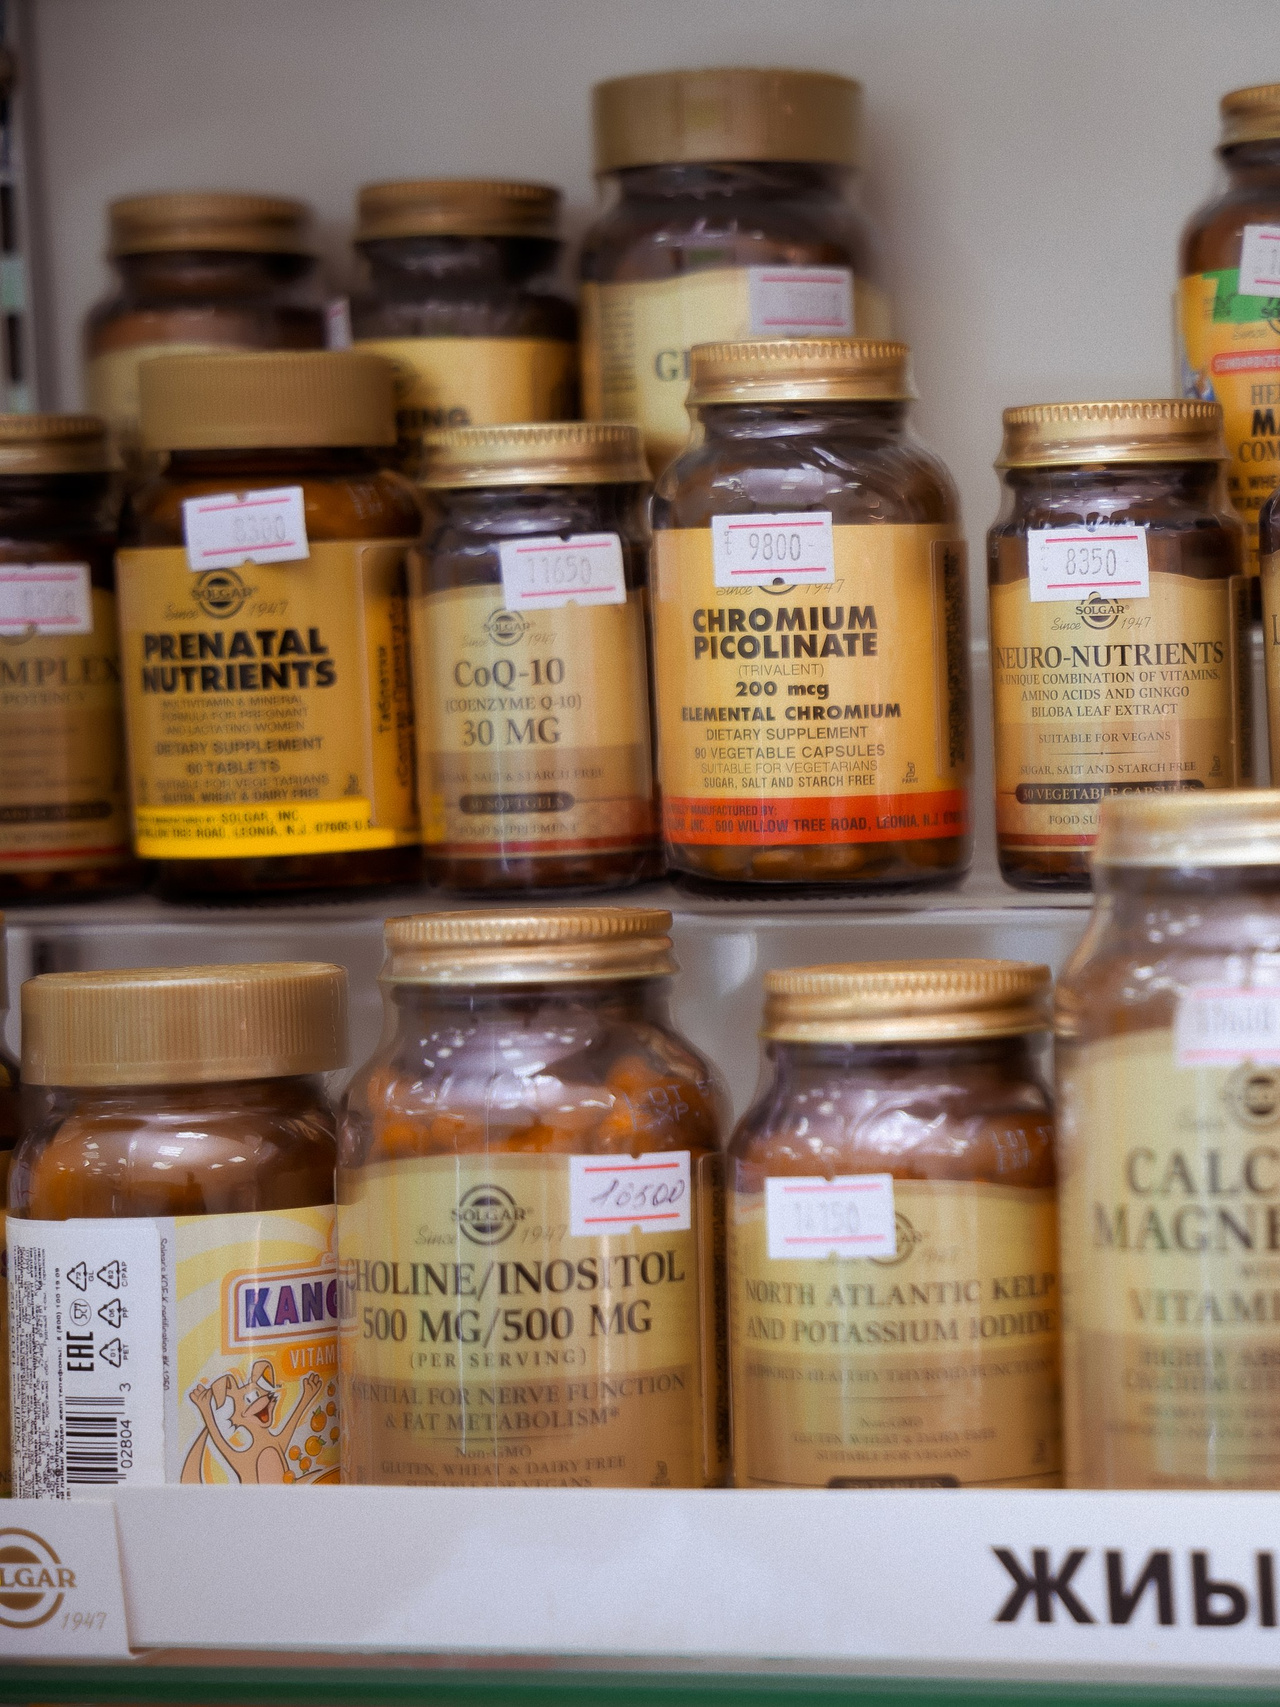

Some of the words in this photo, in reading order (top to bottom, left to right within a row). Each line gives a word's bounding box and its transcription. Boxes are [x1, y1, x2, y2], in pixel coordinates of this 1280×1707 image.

[749, 533, 801, 561] 9800
[1066, 548, 1117, 577] 8350
[1076, 605, 1125, 615] SOLGAR
[693, 606, 877, 633] CHROMIUM
[1051, 618, 1081, 631] Since
[1121, 617, 1151, 629] 1947
[143, 628, 329, 660] PRENATAL
[694, 632, 878, 660] PICOLINATE
[997, 641, 1223, 670] NEURO-NUTRIENTS
[143, 660, 337, 694] NUTRIENTS
[454, 656, 565, 689] CoQ-10
[738, 664, 824, 677] (TRIVALENT)
[1042, 672, 1135, 684] COMBINATION
[1139, 671, 1156, 682] OF
[735, 681, 777, 696] 200
[788, 682, 829, 699] mcg
[1022, 690, 1058, 701] AMINO
[1062, 689, 1100, 700] ACIDS
[1105, 688, 1135, 699] AND
[1139, 686, 1190, 698] GINKGO
[445, 695, 537, 713] (COENZYME
[541, 694, 582, 710] Q-10)
[682, 706, 775, 721] ELEMENTAL
[786, 703, 900, 720] CHROMIUM
[1031, 706, 1073, 718] BILOBA
[1076, 706, 1111, 717] LEAF
[1116, 703, 1178, 716] EXTRACT
[463, 719, 494, 746] 30
[506, 717, 561, 744] MG
[706, 728, 760, 741] DIETARY
[766, 726, 869, 740] SUPPLEMENT
[1038, 733, 1092, 744] SUITABLE
[1095, 733, 1119, 743] FOR
[1123, 731, 1171, 742] VEGANS
[213, 737, 323, 753] SUPPLEMENT
[695, 747, 707, 759] 90
[710, 747, 796, 759] VEGETABLE
[802, 745, 885, 758] CAPSULES
[701, 762, 751, 774] SUITABLE
[755, 762, 782, 773] FOR
[786, 760, 877, 773] VEGETARIANS
[704, 777, 738, 789] SUGAR,
[742, 777, 767, 788] SALT
[770, 776, 793, 787] AND
[798, 776, 844, 787] STARCH
[848, 775, 875, 785] FREE
[745, 1280, 815, 1306] NORTH
[827, 1281, 980, 1308] ATLANTIC
[992, 1273, 1056, 1300] KELP
[363, 1307, 407, 1342] 500
[419, 1306, 574, 1348] MG/500
[589, 1300, 652, 1337] MG
[748, 1315, 786, 1341] AND
[792, 1318, 960, 1344] POTASSIUM
[969, 1309, 1057, 1339] IODIDE
[410, 1351, 456, 1369] (PER
[470, 1349, 587, 1368] SERVING)
[120, 1382, 132, 1391] 3
[120, 1419, 132, 1469] 02804
[61, 1612, 107, 1630] 1947
